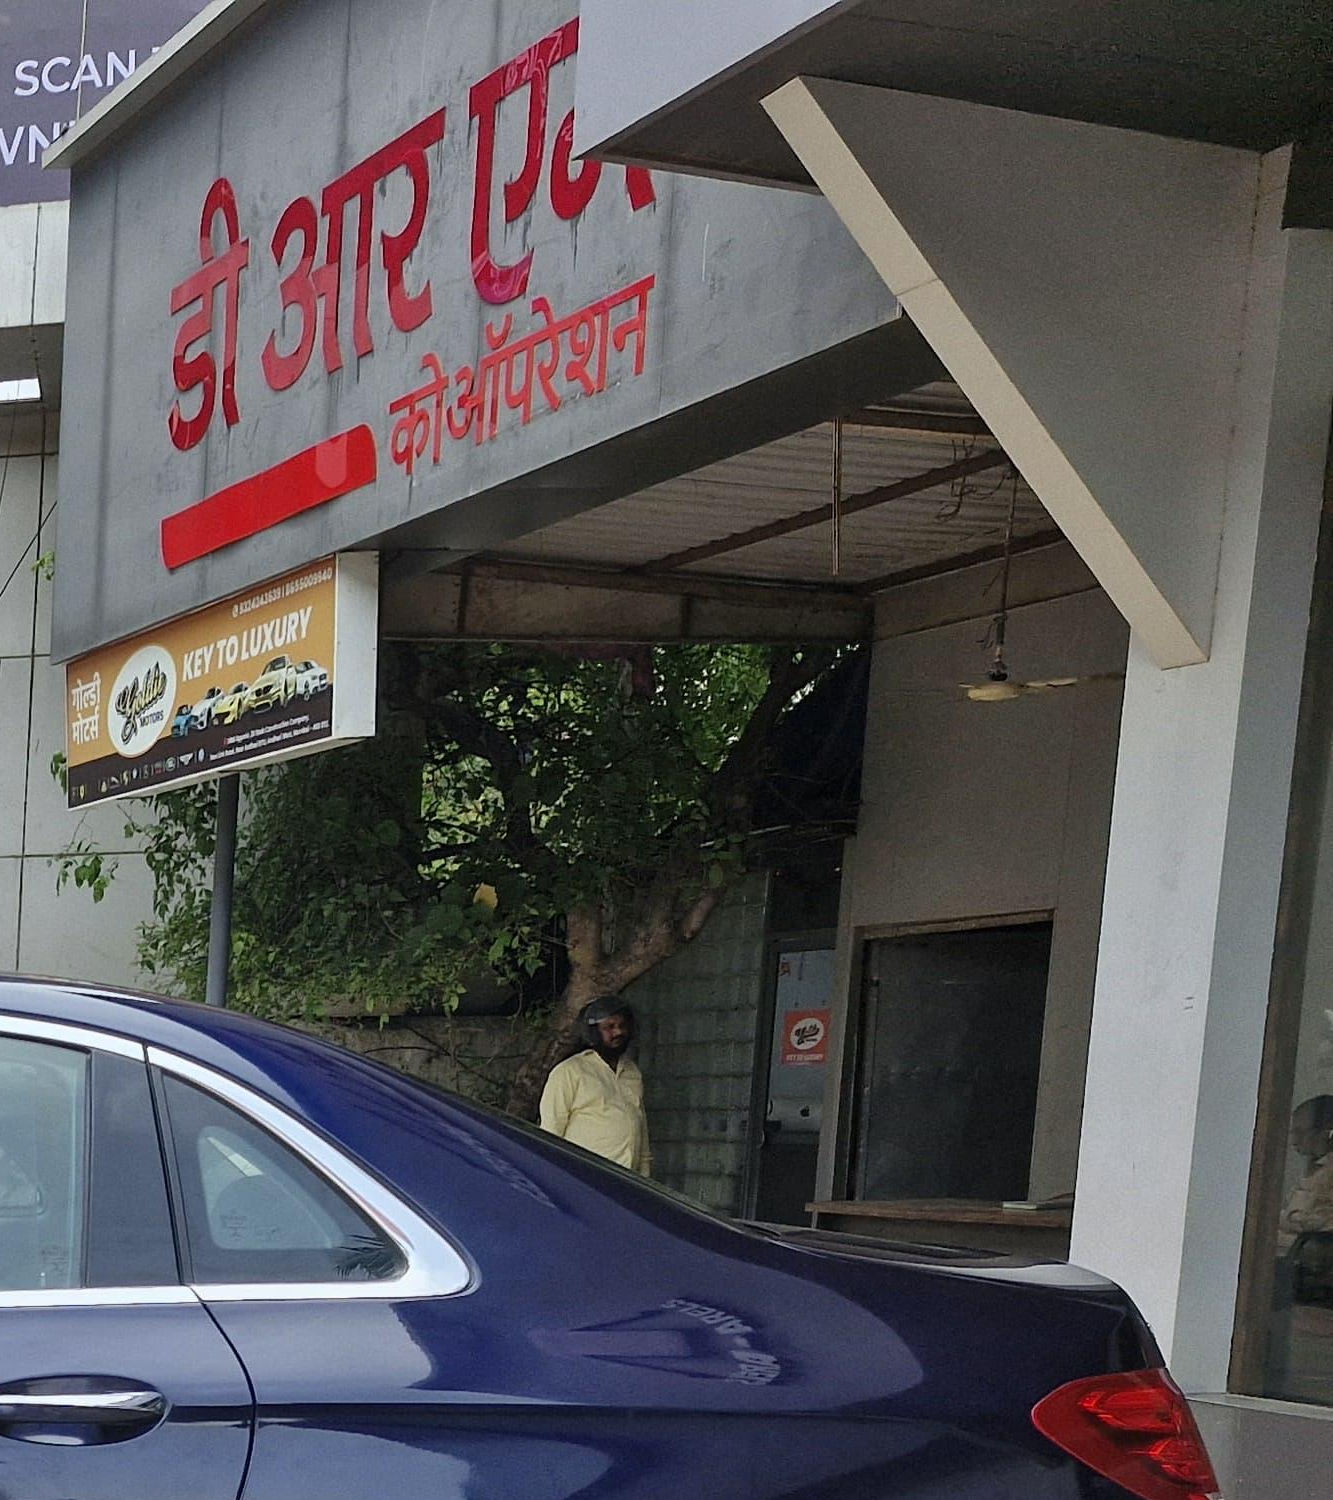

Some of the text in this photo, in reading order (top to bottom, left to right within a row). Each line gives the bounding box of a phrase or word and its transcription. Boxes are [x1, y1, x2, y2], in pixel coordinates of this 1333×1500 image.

[14, 49, 136, 96] SCAN
[168, 177, 249, 451] डी
[261, 106, 446, 391] आर
[389, 274, 655, 475] कोऑपरेशन
[182, 606, 313, 682] KEY TO LUXURY
[71, 671, 101, 711] गोल्डी
[73, 705, 100, 745] मोटर्स
